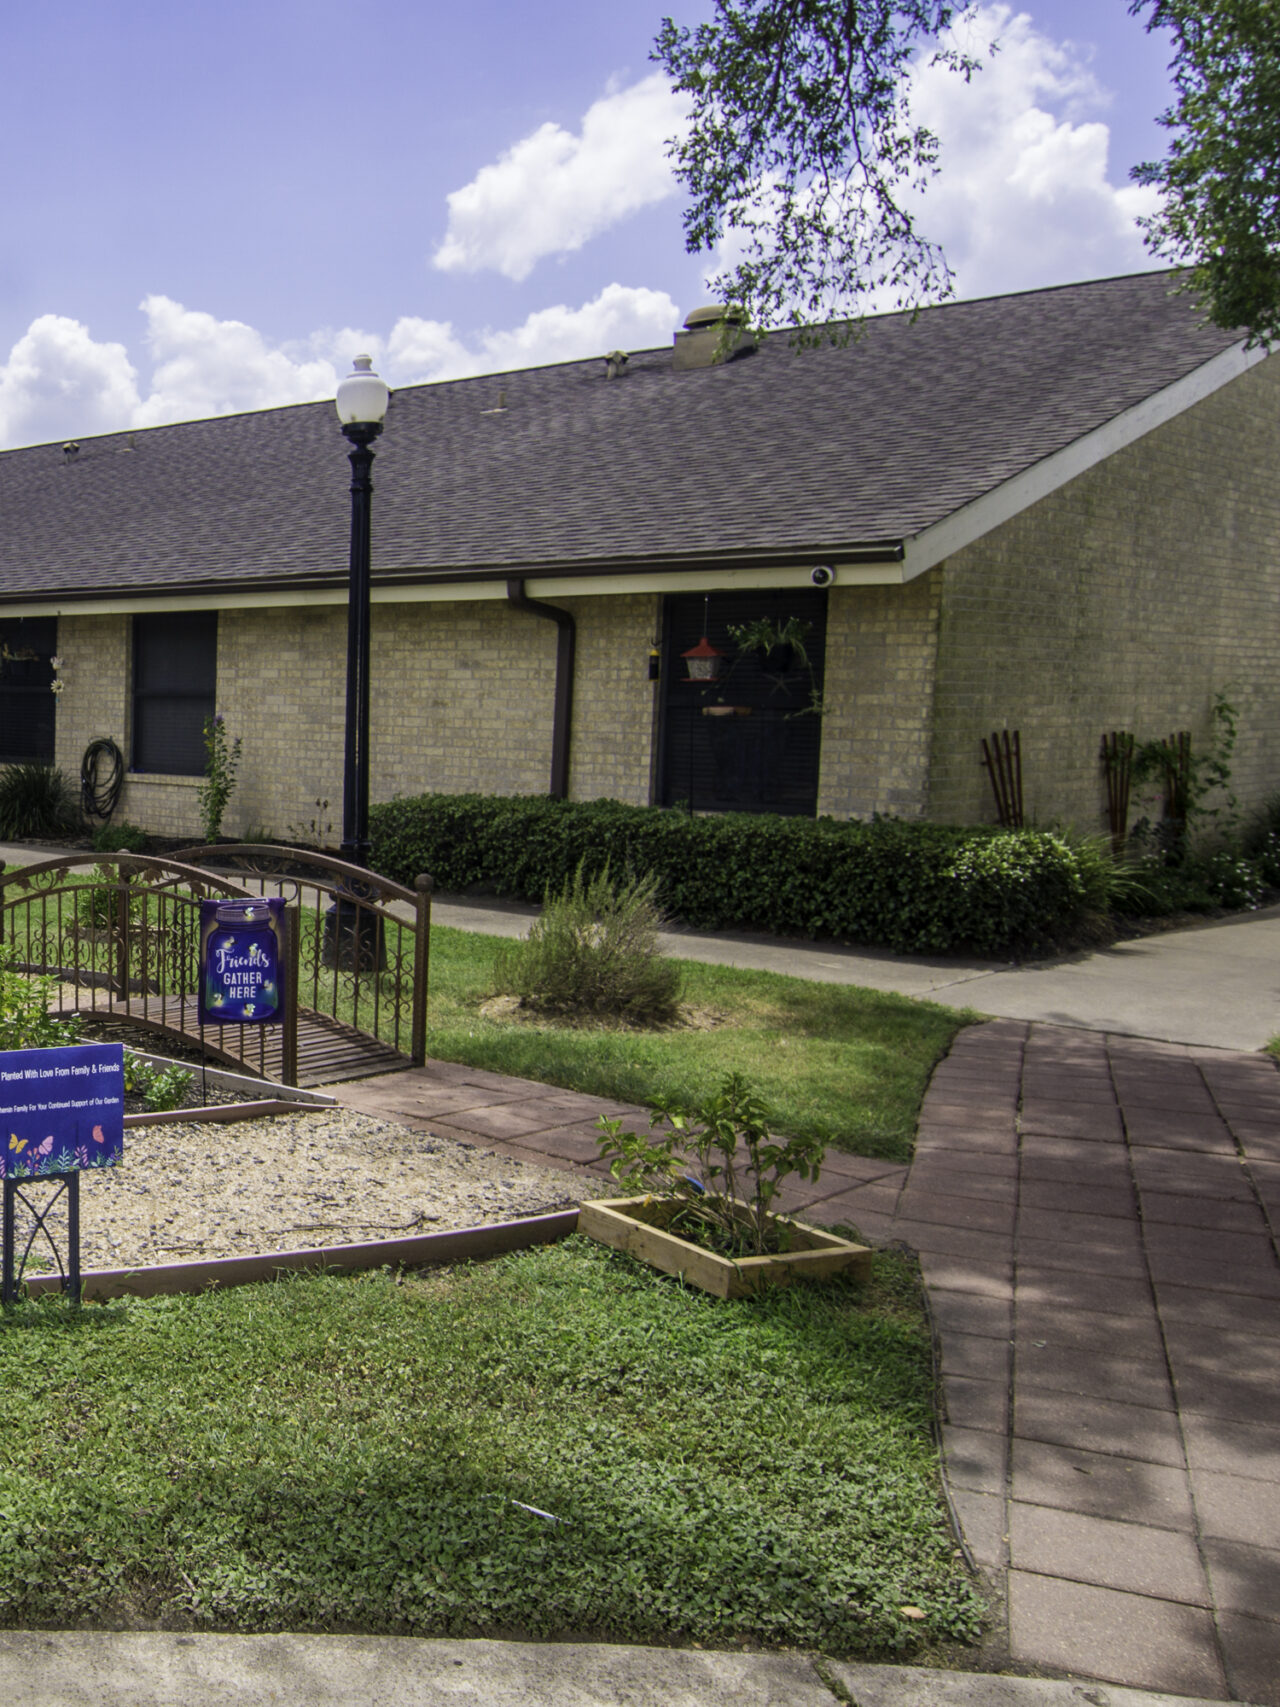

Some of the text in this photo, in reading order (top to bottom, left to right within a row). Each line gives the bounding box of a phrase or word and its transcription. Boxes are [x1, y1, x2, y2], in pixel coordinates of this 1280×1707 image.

[216, 948, 270, 974] Friends
[224, 972, 262, 984] GATHER
[230, 986, 256, 998] HERE
[1, 1070, 23, 1081] Planted
[24, 1069, 38, 1079] With
[40, 1069, 53, 1078] Love
[55, 1068, 70, 1076] From
[71, 1065, 90, 1076] Family
[92, 1064, 97, 1074] &
[99, 1062, 120, 1073] Friends
[14, 1104, 28, 1113] Family
[48, 1100, 70, 1109] Continued
[71, 1100, 88, 1108] Support
